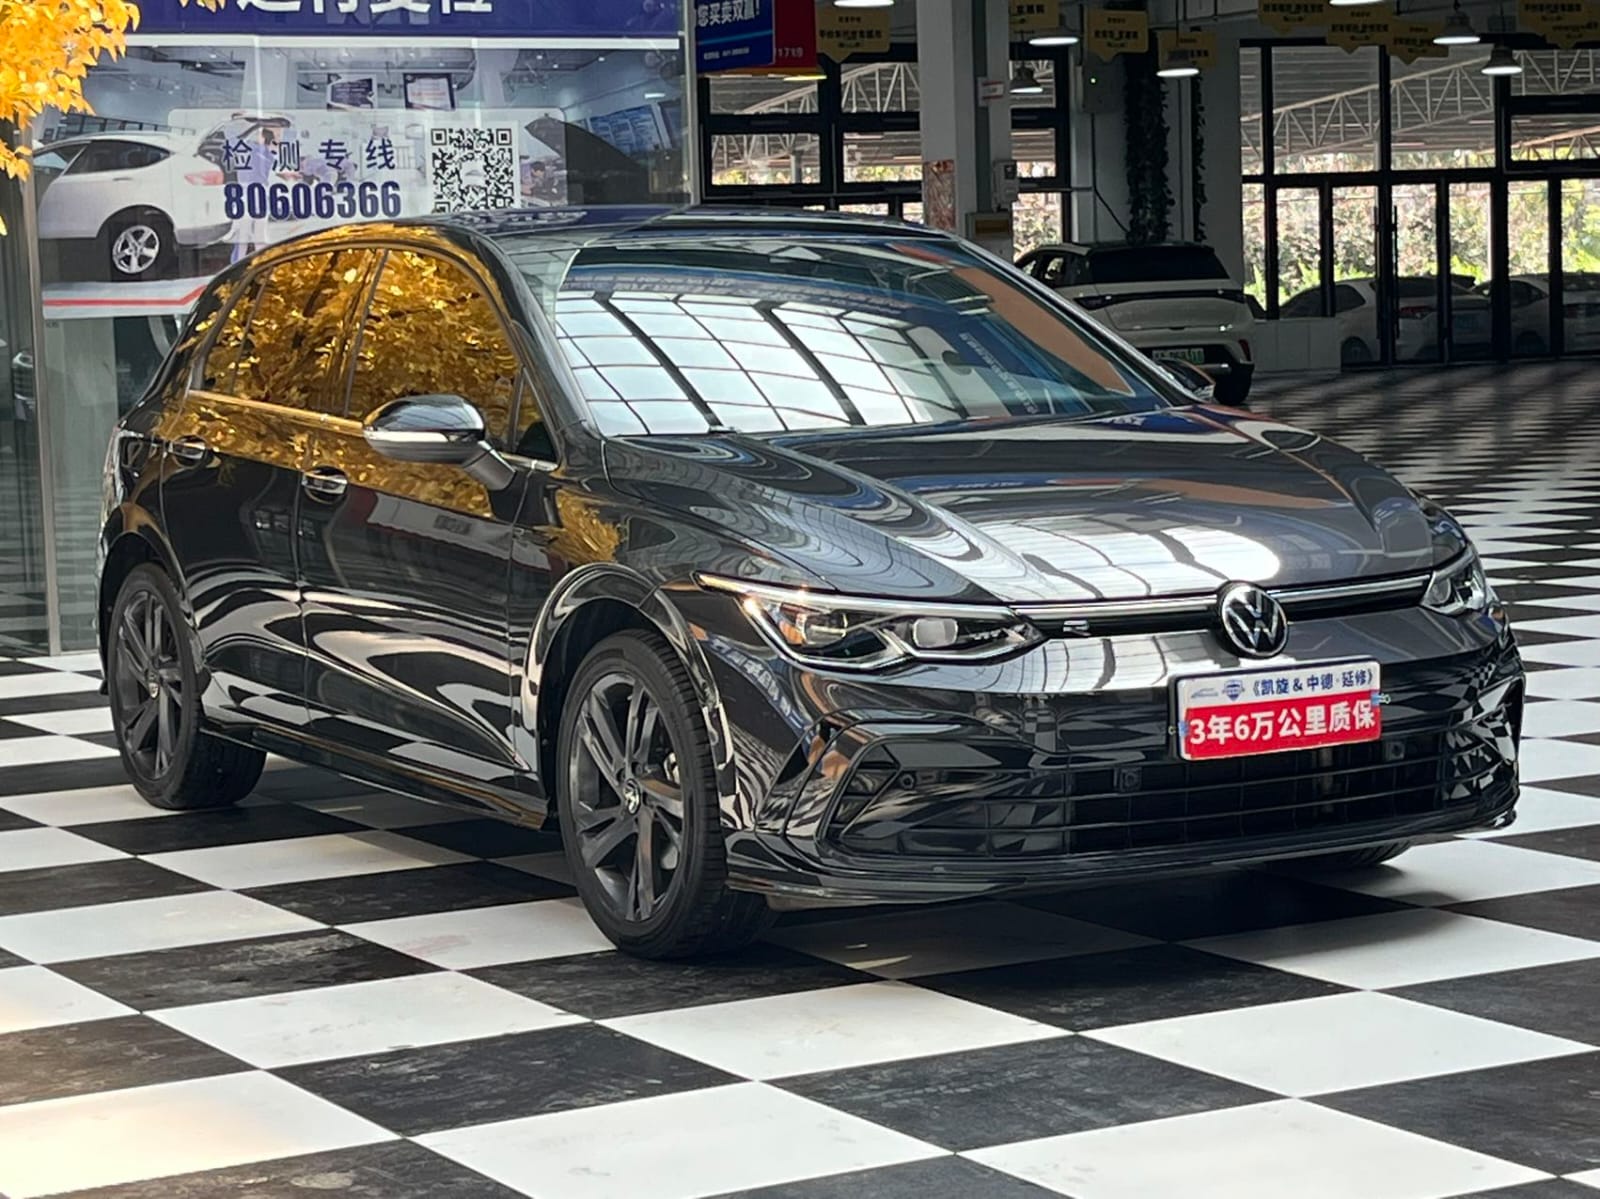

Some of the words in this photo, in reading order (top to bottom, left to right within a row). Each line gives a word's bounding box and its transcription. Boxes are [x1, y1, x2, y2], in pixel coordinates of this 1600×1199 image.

[222, 139, 396, 172] 检测专线
[224, 181, 402, 220] 80606366
[1189, 699, 1375, 745] 3年6万公里质保
